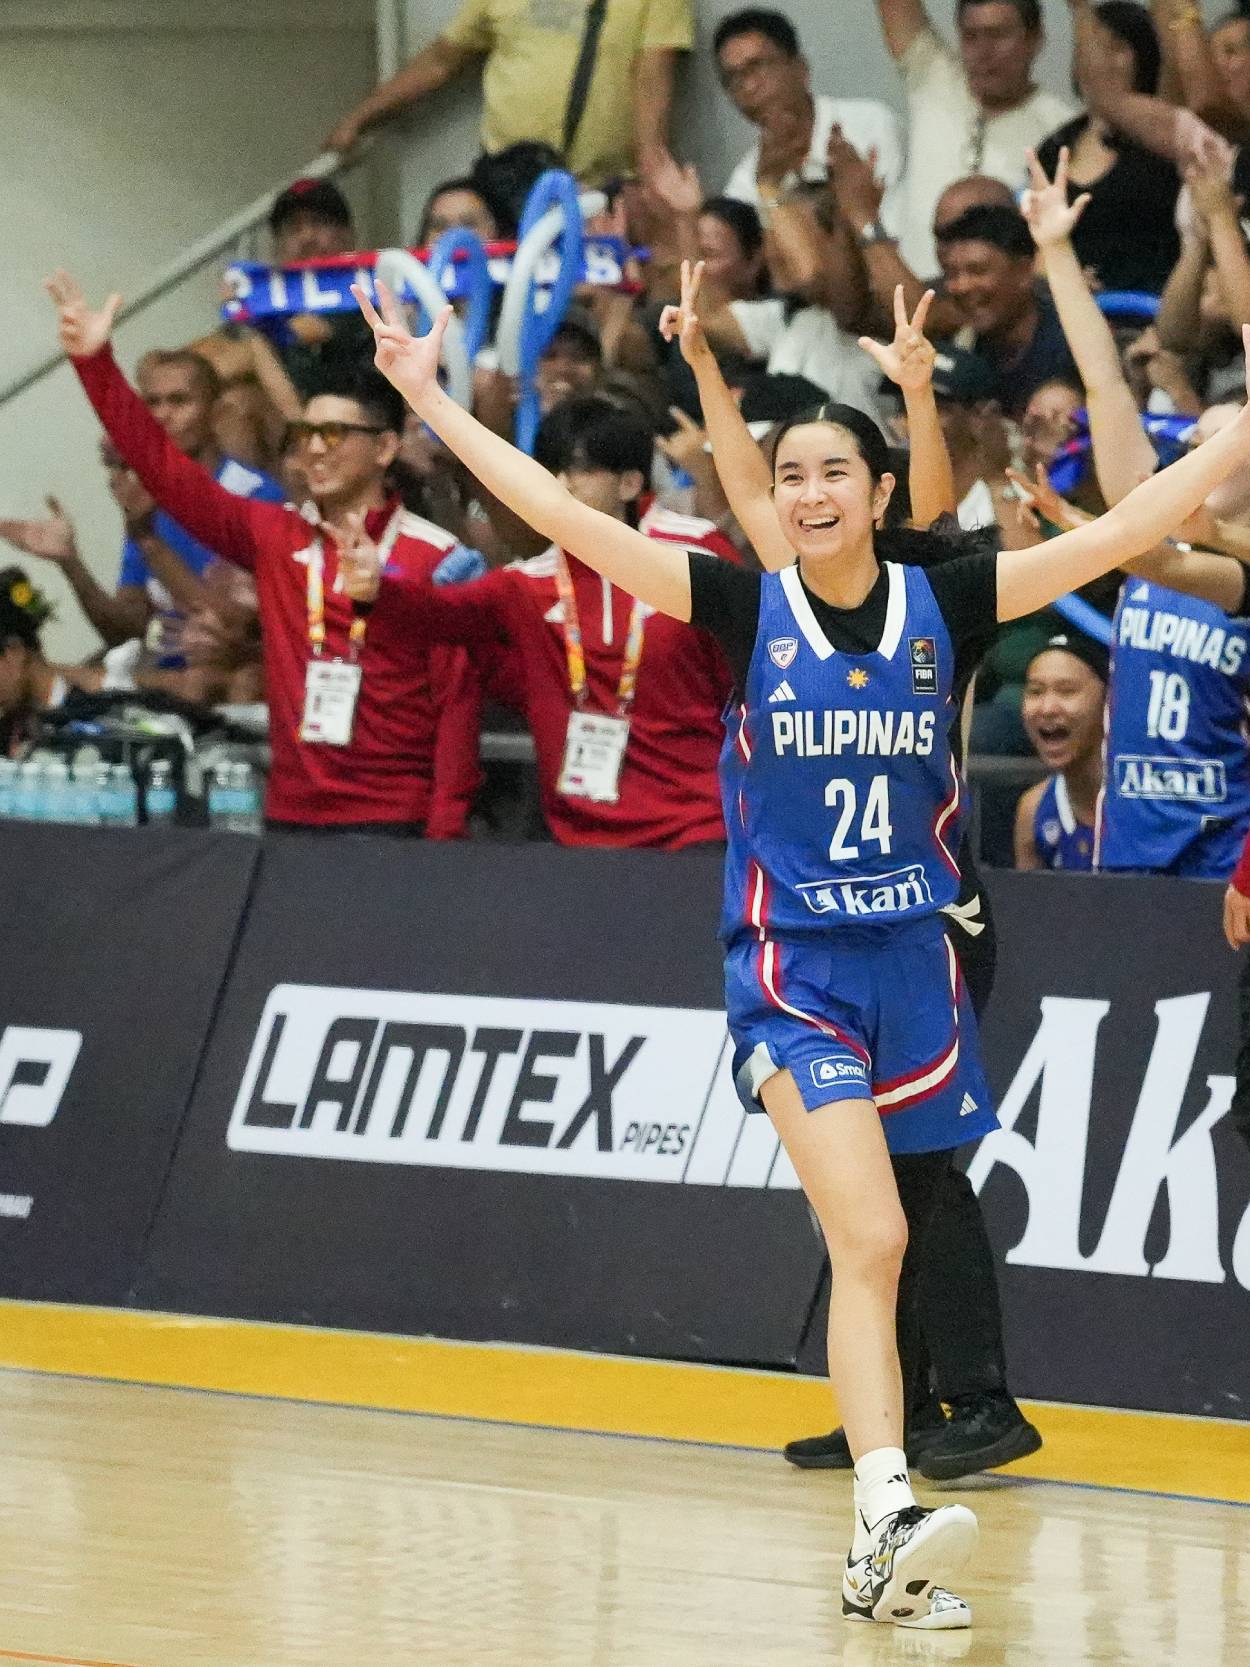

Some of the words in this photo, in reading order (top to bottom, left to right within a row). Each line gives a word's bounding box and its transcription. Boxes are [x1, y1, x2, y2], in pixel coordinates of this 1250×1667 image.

[1120, 606, 1247, 675] PILIPINAS
[771, 710, 936, 757] PILIPINAS
[1147, 670, 1190, 742] 18
[1122, 762, 1217, 795] Akari
[824, 775, 893, 861] 24
[243, 1013, 647, 1152] LAMTEX
[836, 1062, 864, 1077] Sma
[618, 1121, 691, 1155] PIPES
